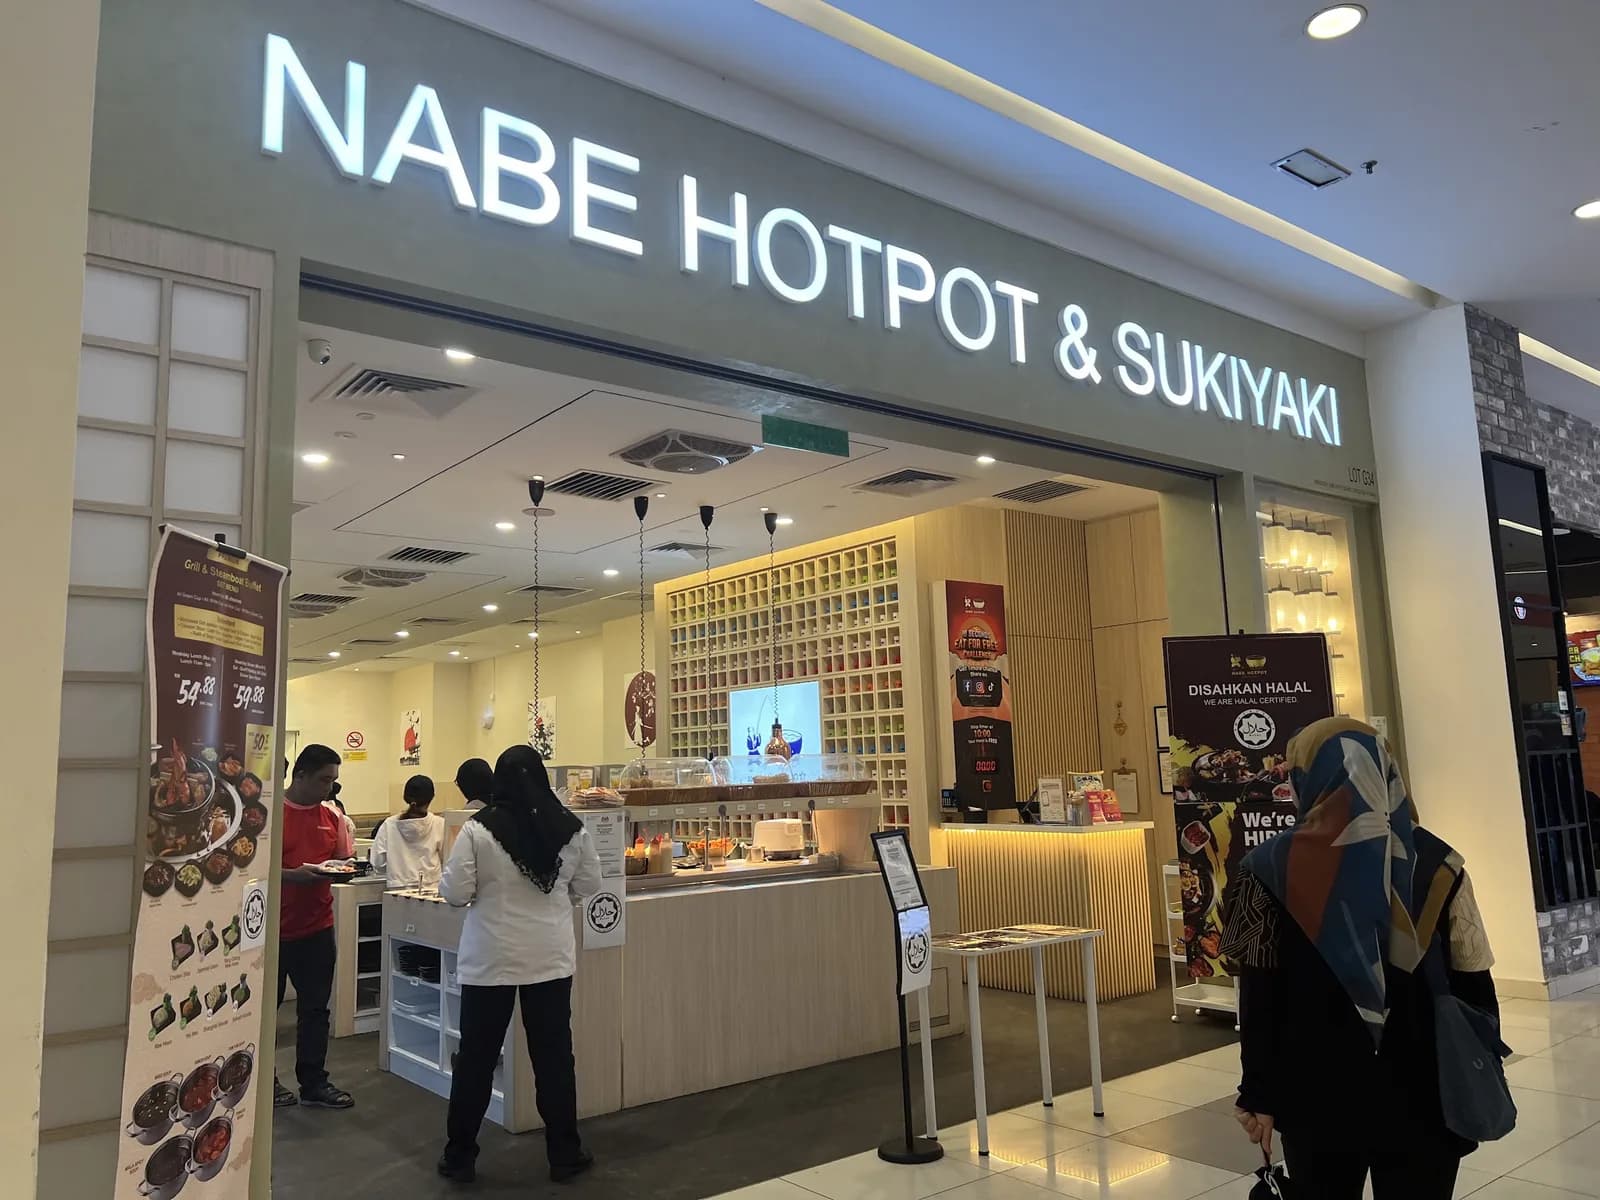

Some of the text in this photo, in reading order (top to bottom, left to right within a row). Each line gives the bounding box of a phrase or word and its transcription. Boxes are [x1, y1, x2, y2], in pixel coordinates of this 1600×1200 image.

[261, 33, 1341, 446] NABE HOTPOT & SUKIYAKI
[1348, 466, 1361, 484] LOT
[184, 559, 201, 573] Grill
[202, 564, 208, 574] &
[1188, 681, 1313, 696] DISAHKAN HALAL
[1203, 696, 1297, 706] WE ARE HALAL CERTIFIED
[1242, 811, 1296, 827] We're
